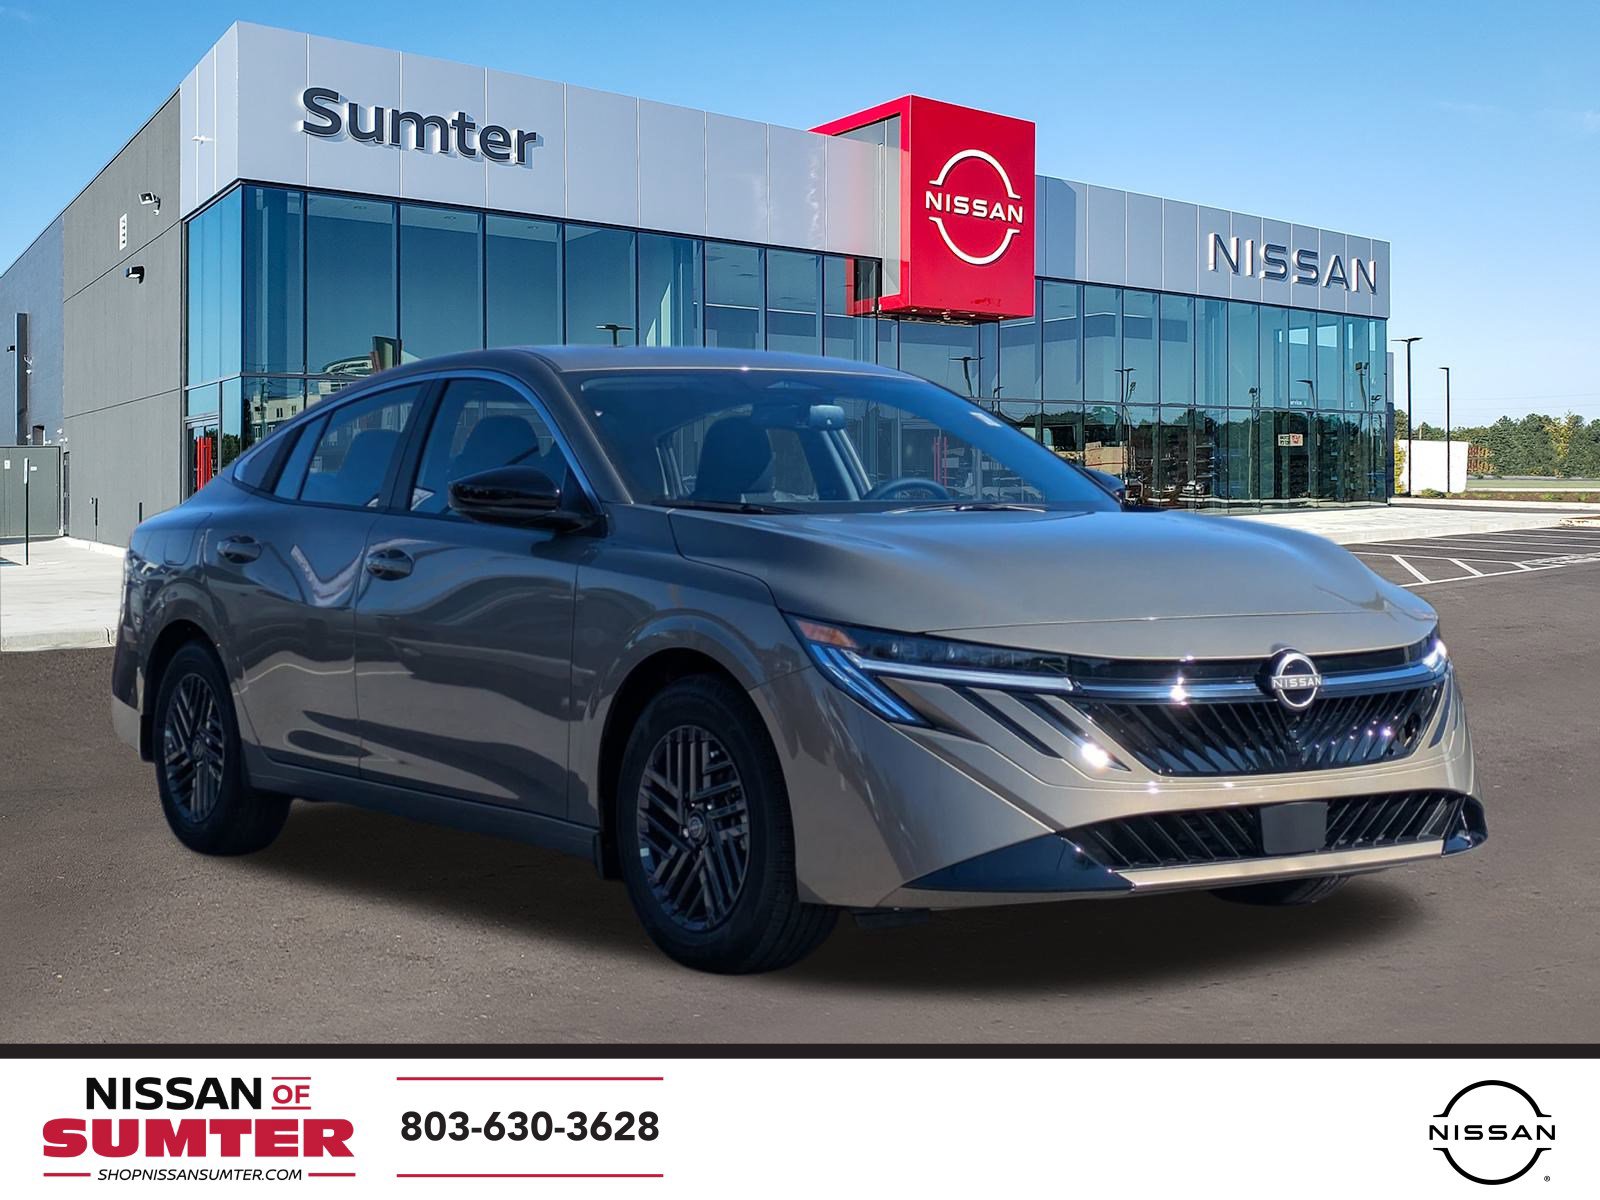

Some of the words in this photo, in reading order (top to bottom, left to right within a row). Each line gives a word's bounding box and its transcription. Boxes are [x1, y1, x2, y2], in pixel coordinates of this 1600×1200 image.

[299, 86, 538, 166] Sumter
[925, 190, 1024, 224] NISSAN
[1208, 232, 1377, 294] NISSAN
[1272, 676, 1321, 688] NISSAN
